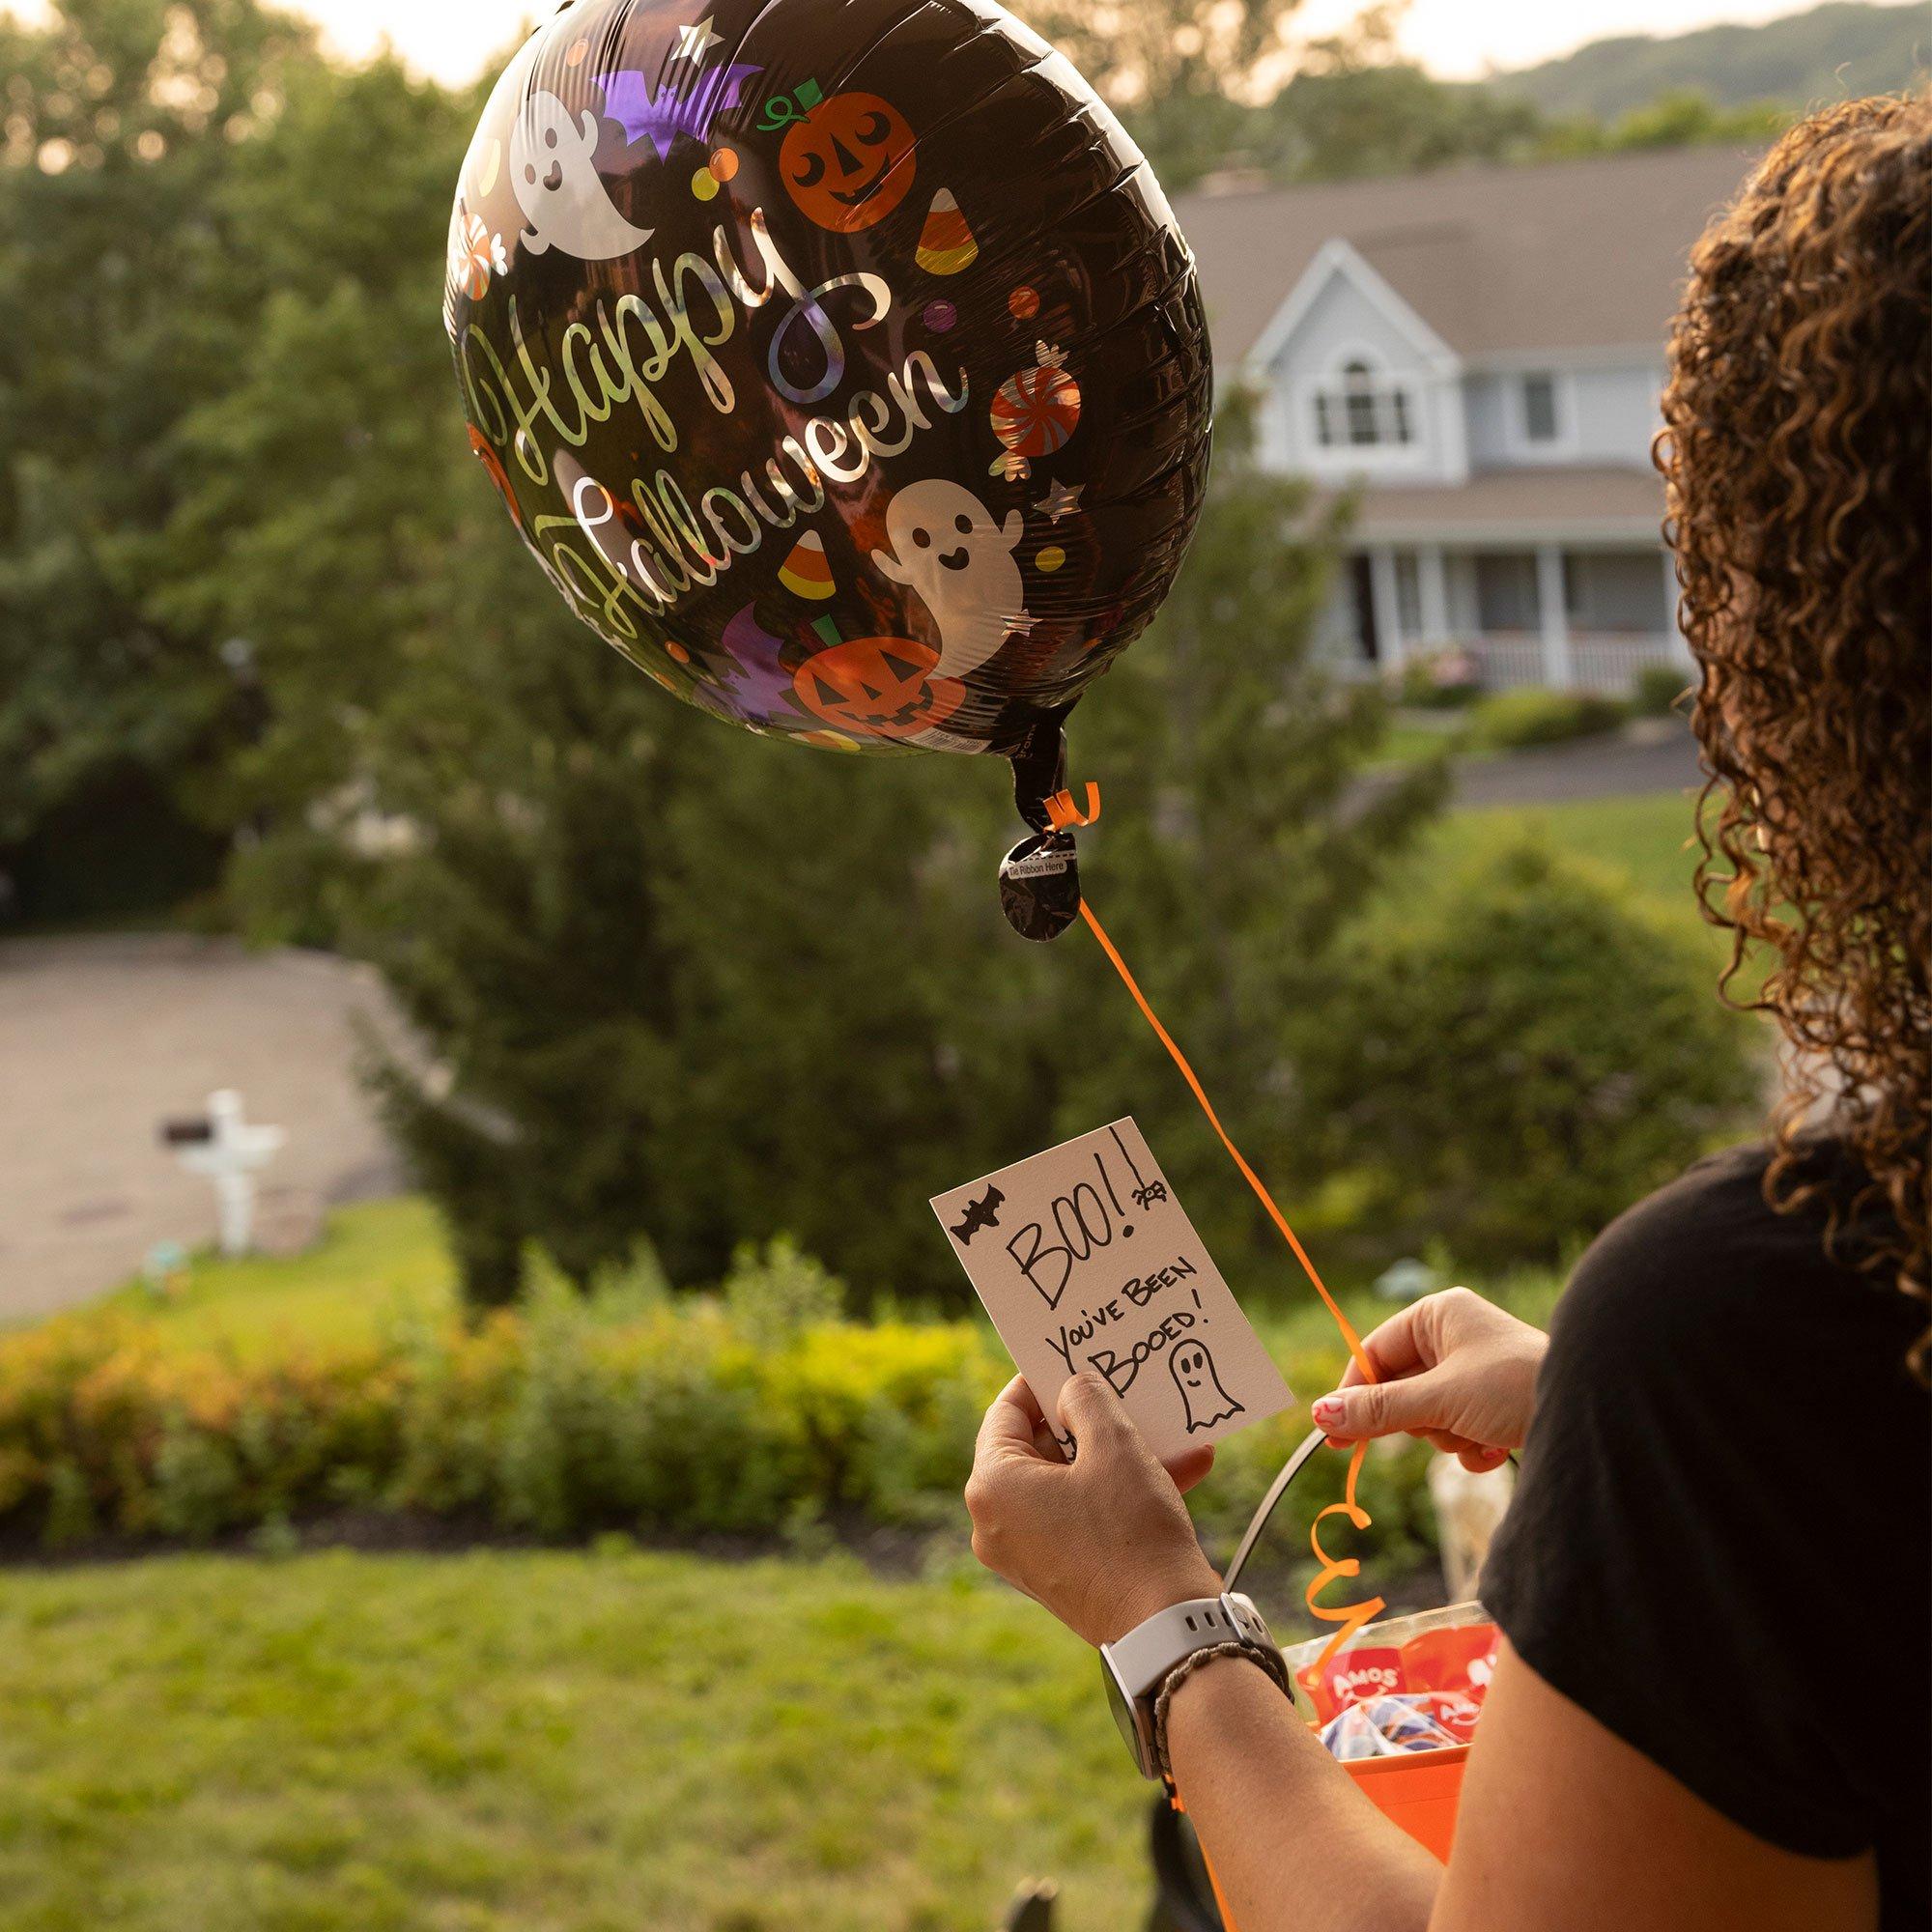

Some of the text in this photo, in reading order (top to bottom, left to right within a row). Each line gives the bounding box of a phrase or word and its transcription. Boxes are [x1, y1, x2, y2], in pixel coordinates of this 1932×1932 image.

[460, 206, 892, 486] Happy
[534, 350, 969, 639] Halloween
[1009, 863, 1064, 875] Tie Ribbon Here
[1006, 1152, 1136, 1311] BOO!
[1121, 1256, 1198, 1307] BEEN
[1087, 1288, 1209, 1399] BOOED!
[1332, 1666, 1399, 1701] AMOS
